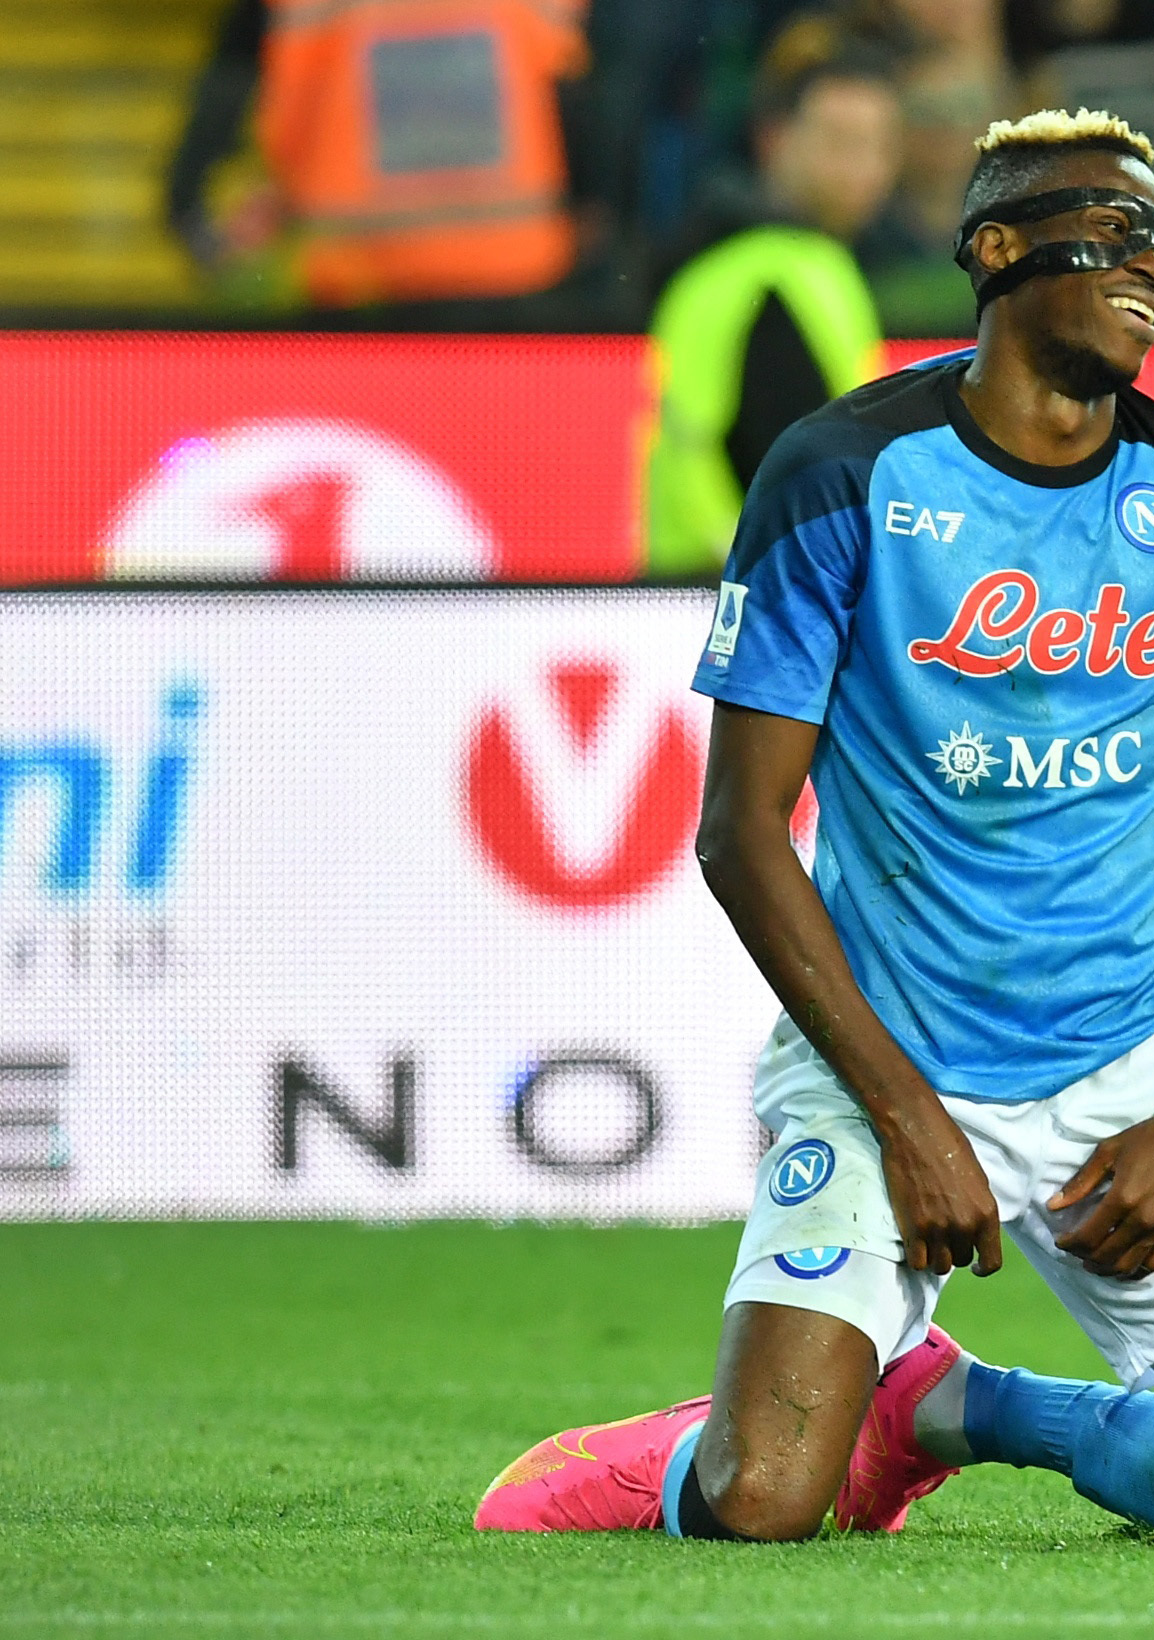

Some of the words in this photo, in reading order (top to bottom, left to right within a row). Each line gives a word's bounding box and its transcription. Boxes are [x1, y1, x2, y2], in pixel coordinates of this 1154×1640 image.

[885, 500, 966, 543] EA7
[1002, 730, 1143, 789] MSC
[783, 1154, 819, 1190] N
